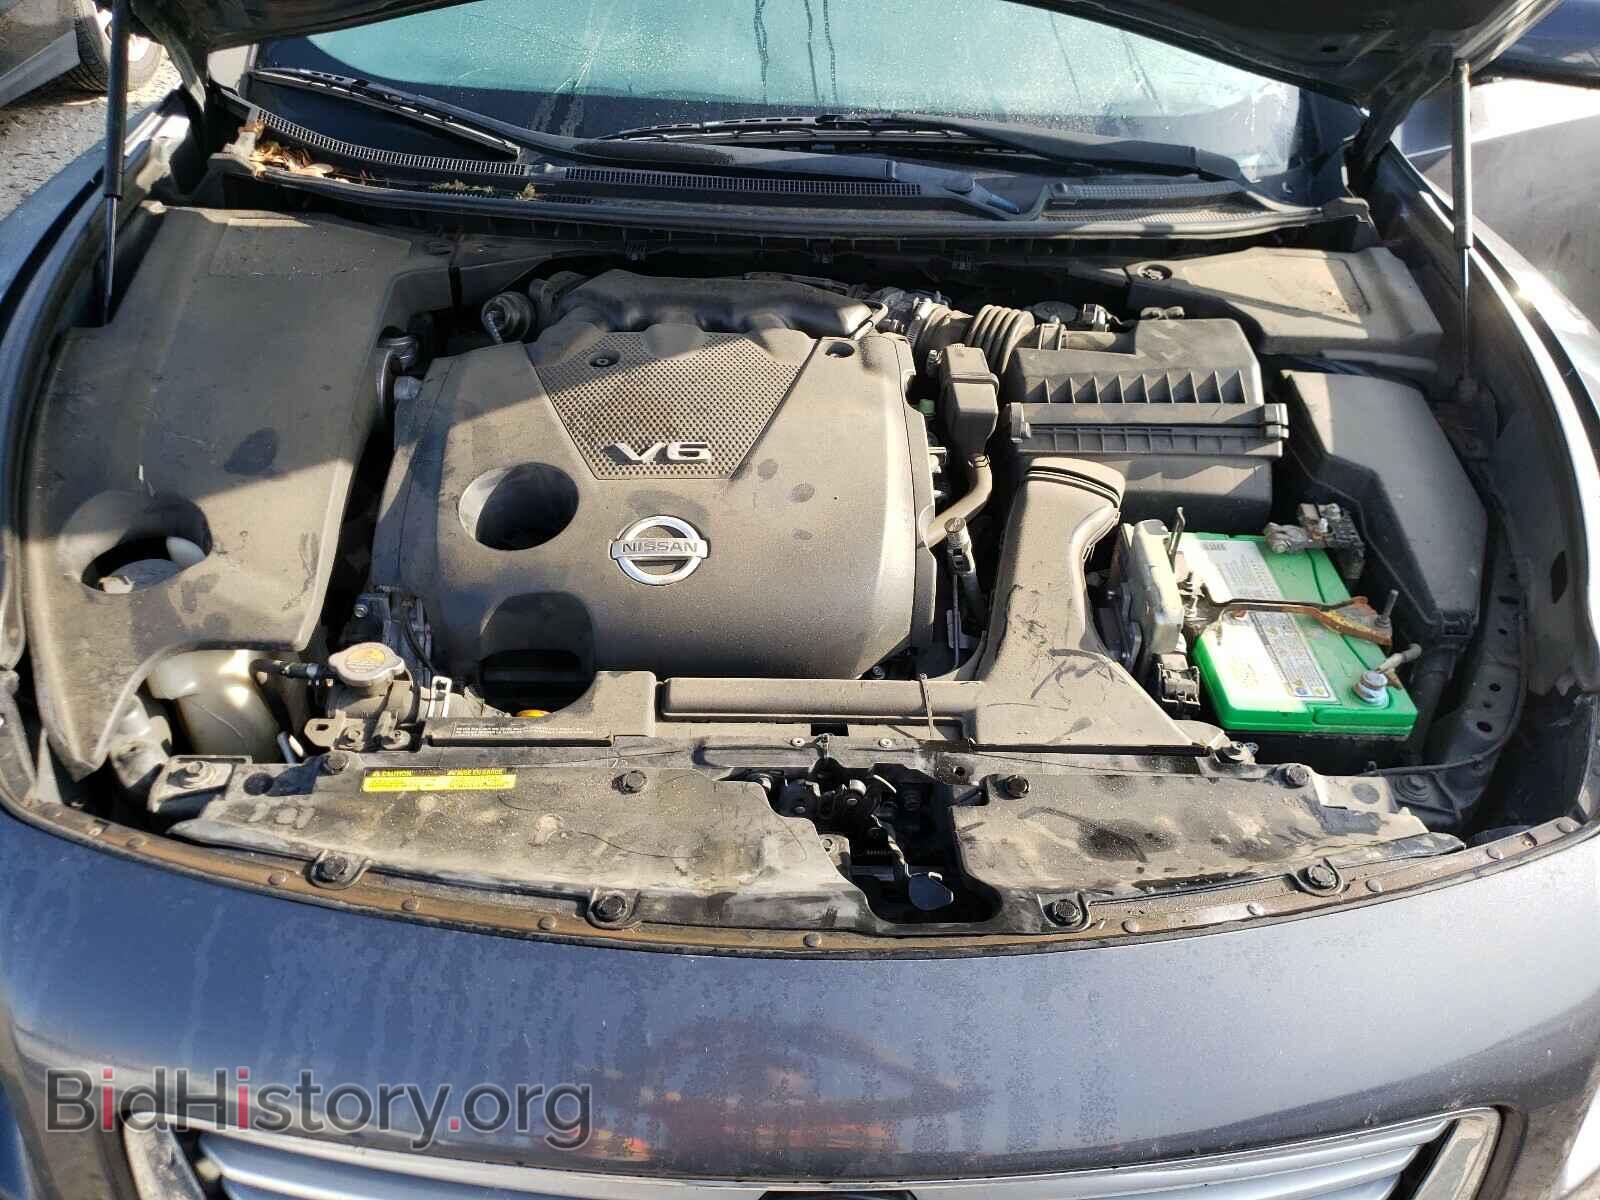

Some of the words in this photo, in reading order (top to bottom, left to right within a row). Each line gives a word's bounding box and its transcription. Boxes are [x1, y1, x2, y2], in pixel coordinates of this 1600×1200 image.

[604, 441, 711, 464] V6
[622, 541, 698, 553] NISSAN
[382, 769, 412, 777] CAUTION
